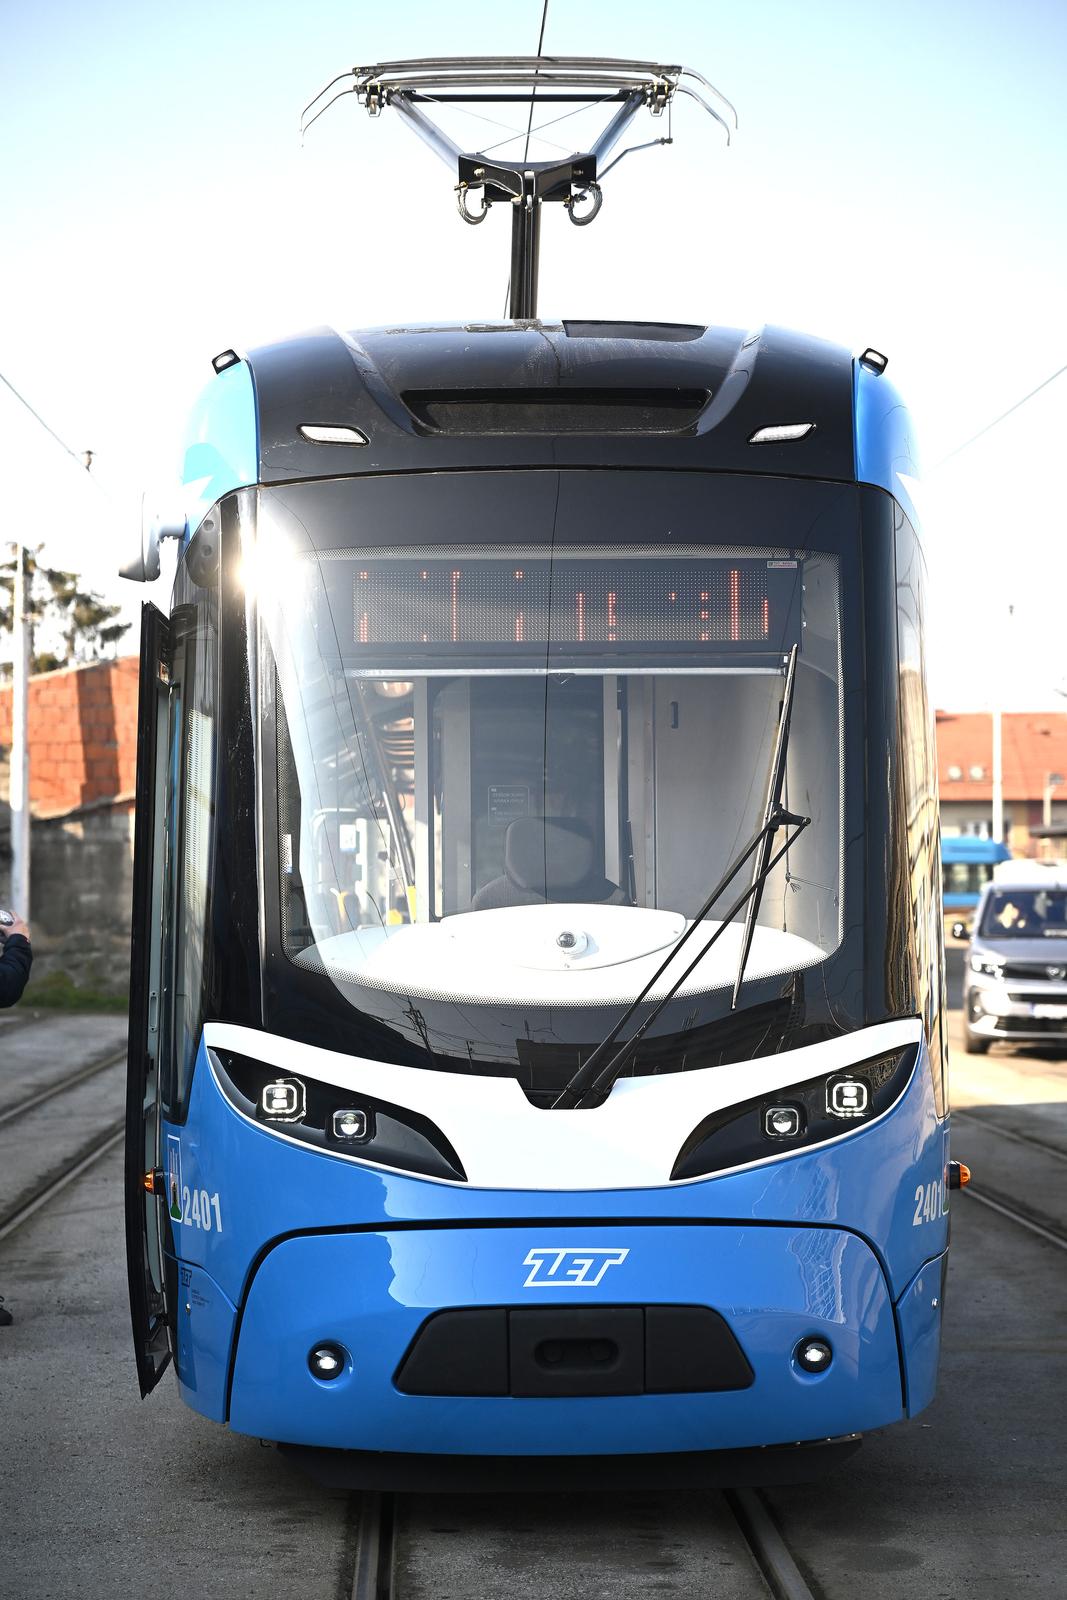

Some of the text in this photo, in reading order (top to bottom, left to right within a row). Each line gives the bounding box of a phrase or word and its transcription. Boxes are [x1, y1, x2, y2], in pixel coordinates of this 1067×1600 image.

[183, 1185, 223, 1233] 2401
[912, 1179, 942, 1226] 2401
[522, 1247, 631, 1288] ZET
